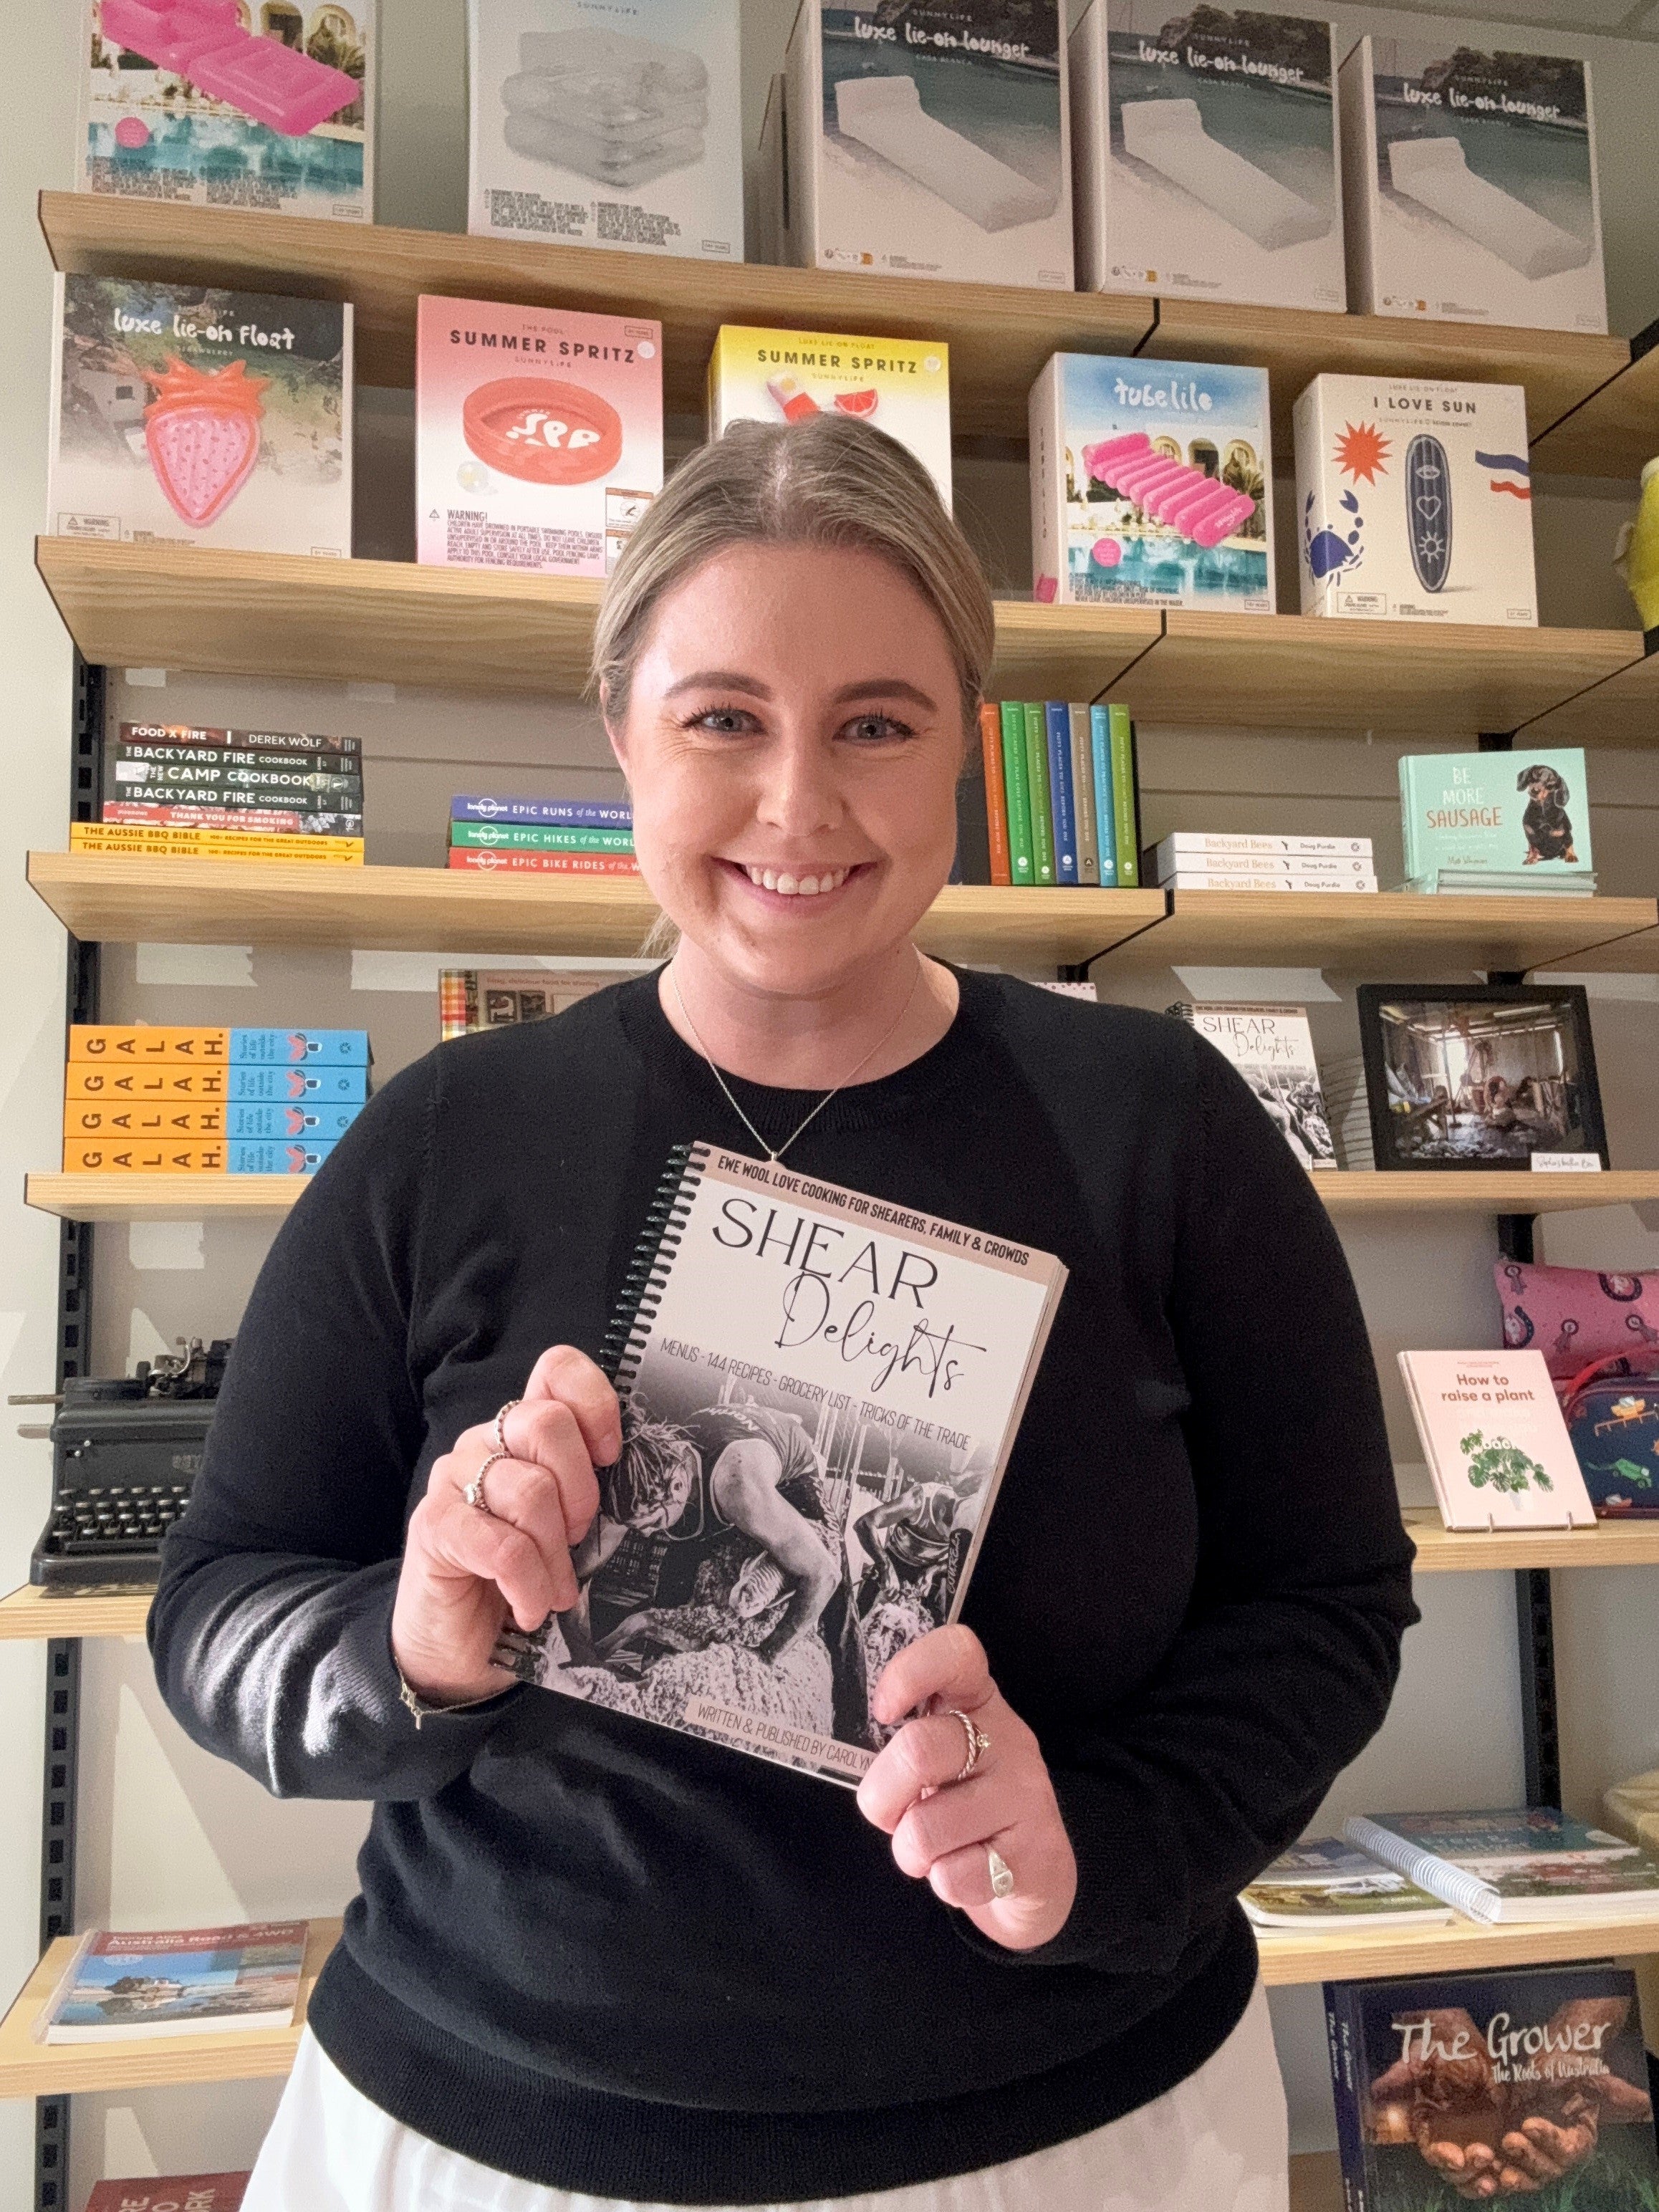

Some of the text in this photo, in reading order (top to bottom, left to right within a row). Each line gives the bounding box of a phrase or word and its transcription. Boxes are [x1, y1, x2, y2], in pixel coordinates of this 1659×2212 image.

[855, 16, 1029, 59] luxe lie-on lounger
[1139, 40, 1304, 83] luxe lie-on lounger
[1403, 82, 1443, 107] luxe
[1502, 94, 1561, 120] lounger
[114, 307, 163, 335] luxe
[173, 314, 233, 342] lie-on
[451, 330, 635, 363] SUMMER SPRITZ
[514, 356, 572, 368] SUNNYLIFE
[758, 349, 917, 374] SUMMER SPRITZ
[811, 372, 865, 383] SUNNYLIFE
[1374, 397, 1476, 413] I LOVE SUN
[447, 509, 488, 521] WARNING!
[132, 727, 166, 737] FOOD
[181, 731, 207, 740] FIRE
[249, 734, 286, 745] DEREK
[289, 737, 322, 748] WOLF
[134, 746, 218, 762] BACKYARD
[223, 752, 255, 764] FIRE
[259, 756, 307, 766] COOKBOOK
[168, 766, 221, 782] CAMP
[227, 771, 310, 787] COOKBOOK
[1453, 766, 1471, 785] BE
[134, 787, 218, 802] BACKYARD
[223, 792, 255, 803] FIRE
[259, 795, 307, 804] COOKBOOK
[1443, 787, 1484, 806] MORE
[170, 812, 203, 820] THANK
[247, 817, 294, 825] SMOKING
[513, 805, 538, 815] EPIC
[542, 807, 573, 817] RUNS
[577, 809, 585, 817] of
[599, 809, 633, 819] WORL
[1426, 807, 1503, 829] SAUSAGE
[84, 827, 105, 837] THE
[107, 828, 144, 837] AUSSIE
[148, 830, 169, 840] BBQ
[468, 831, 489, 840] lonely
[514, 833, 538, 842] EPIC
[544, 835, 577, 844] HIKES
[580, 836, 587, 845] of
[602, 837, 635, 846] WORL
[82, 842, 102, 851] THE
[105, 843, 142, 852] AUSSIE
[146, 845, 167, 855] BBQ
[1205, 838, 1248, 850] Backyard
[1251, 840, 1273, 850] Bees
[512, 857, 538, 867] EPIC
[542, 860, 567, 869] BIKE
[572, 860, 605, 870] RIDES
[1206, 857, 1249, 870] Backyard
[1252, 860, 1274, 869] Bees
[1208, 878, 1251, 890] Backyard
[1254, 880, 1276, 889] Bees
[1203, 1016, 1275, 1034] SHEAR
[1233, 1032, 1299, 1062] Delights
[718, 1155, 1029, 1266] EWE WOOL LOVE COOKING FOR SHEARERS, FAMILY & CROWDS
[711, 1198, 938, 1309] SHEAR
[774, 1271, 987, 1398] Delights
[1456, 1374, 1509, 1385] How to
[660, 1337, 700, 1362] MENUS
[706, 1352, 728, 1371] 144
[728, 1359, 772, 1386] RECIPES
[779, 1375, 828, 1403] GROCERY
[827, 1391, 852, 1412] LIST
[860, 1400, 897, 1426] TRICKS
[897, 1413, 913, 1430] OF
[915, 1418, 934, 1439] THE
[936, 1425, 971, 1451] TRADE
[1441, 1389, 1535, 1404] raise a plant
[698, 1703, 874, 1771] WRITTEN & PUBLISHED BY CAROLYN
[1392, 2012, 1612, 2066] The Grower
